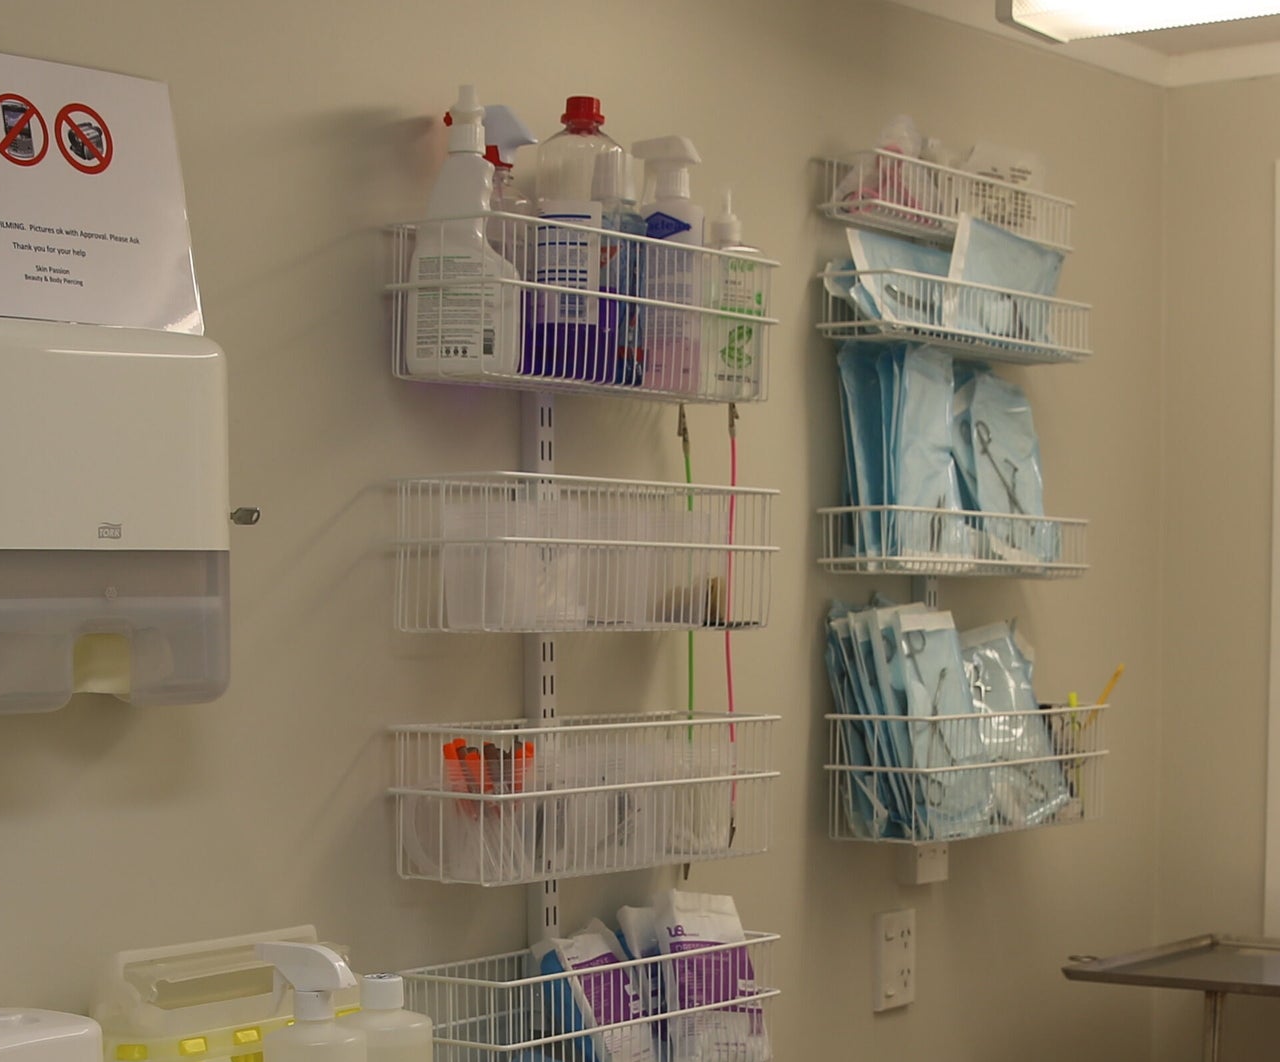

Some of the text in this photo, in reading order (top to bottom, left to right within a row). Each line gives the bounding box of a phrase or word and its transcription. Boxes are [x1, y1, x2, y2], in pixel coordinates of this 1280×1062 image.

[29, 224, 55, 234] Pictures
[56, 227, 64, 235] ok
[80, 230, 109, 240] Approval.
[110, 234, 128, 242] Please
[129, 236, 140, 244] Ask
[12, 241, 32, 250] Thank
[46, 245, 56, 253] for
[72, 248, 87, 257] help
[49, 266, 70, 274] Passion
[24, 273, 43, 282] Beauty
[49, 276, 63, 284] Body
[63, 278, 84, 287] Piercing
[99, 528, 121, 538] TORK
